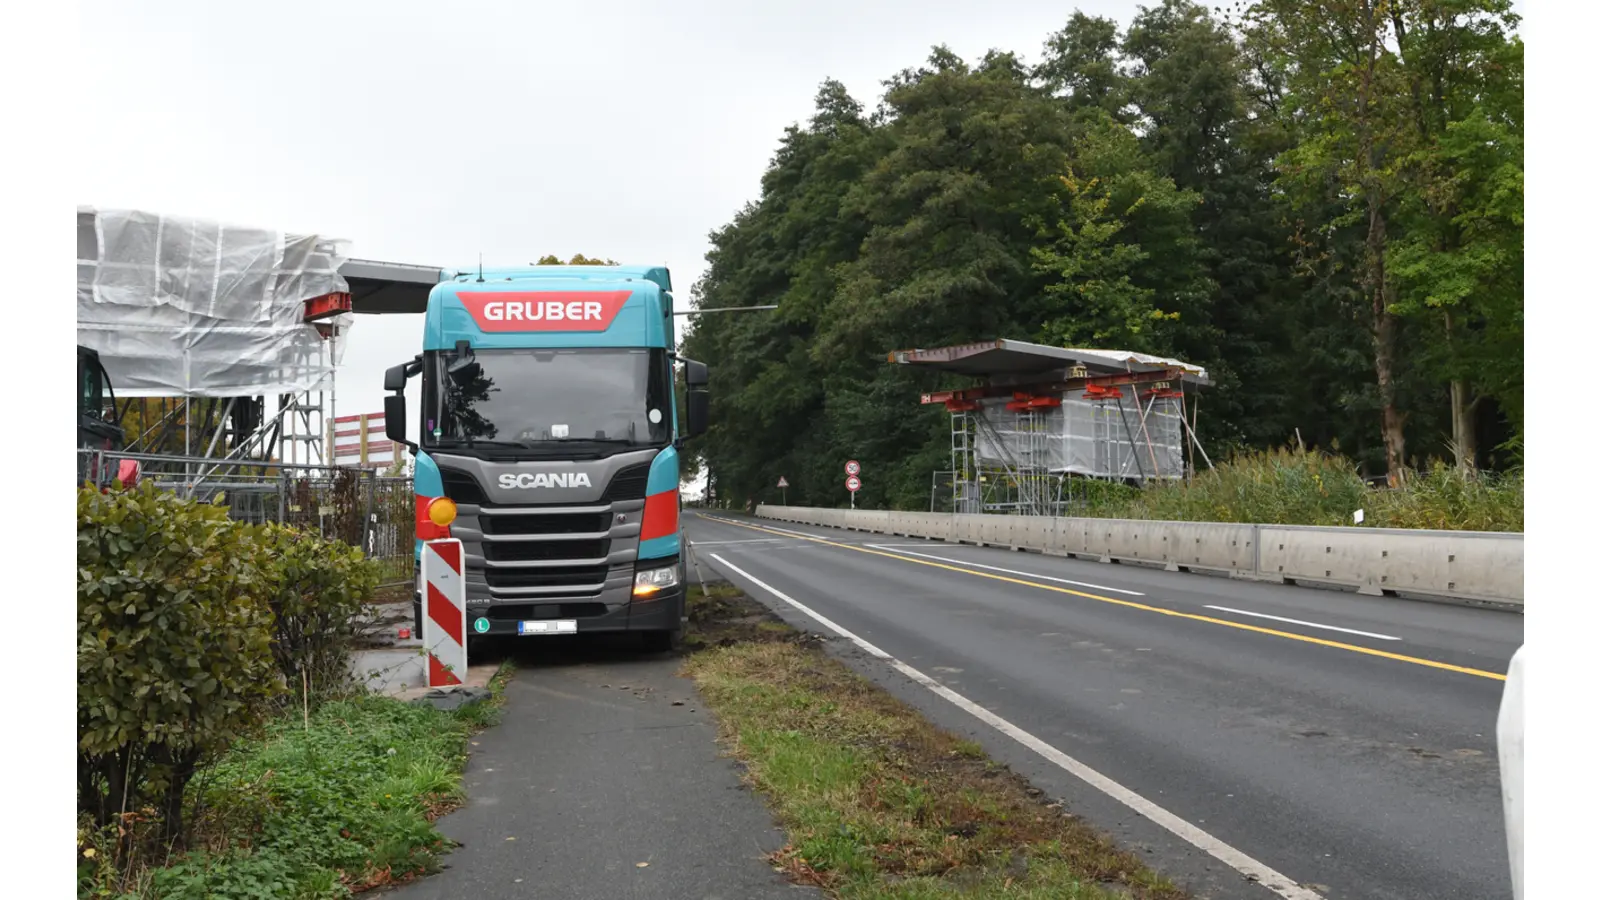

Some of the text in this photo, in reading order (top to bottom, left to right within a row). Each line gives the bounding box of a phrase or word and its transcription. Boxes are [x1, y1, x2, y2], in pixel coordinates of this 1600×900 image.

[483, 301, 602, 321] GRUBER
[498, 472, 592, 490] SCANIA
[478, 620, 486, 631] L
